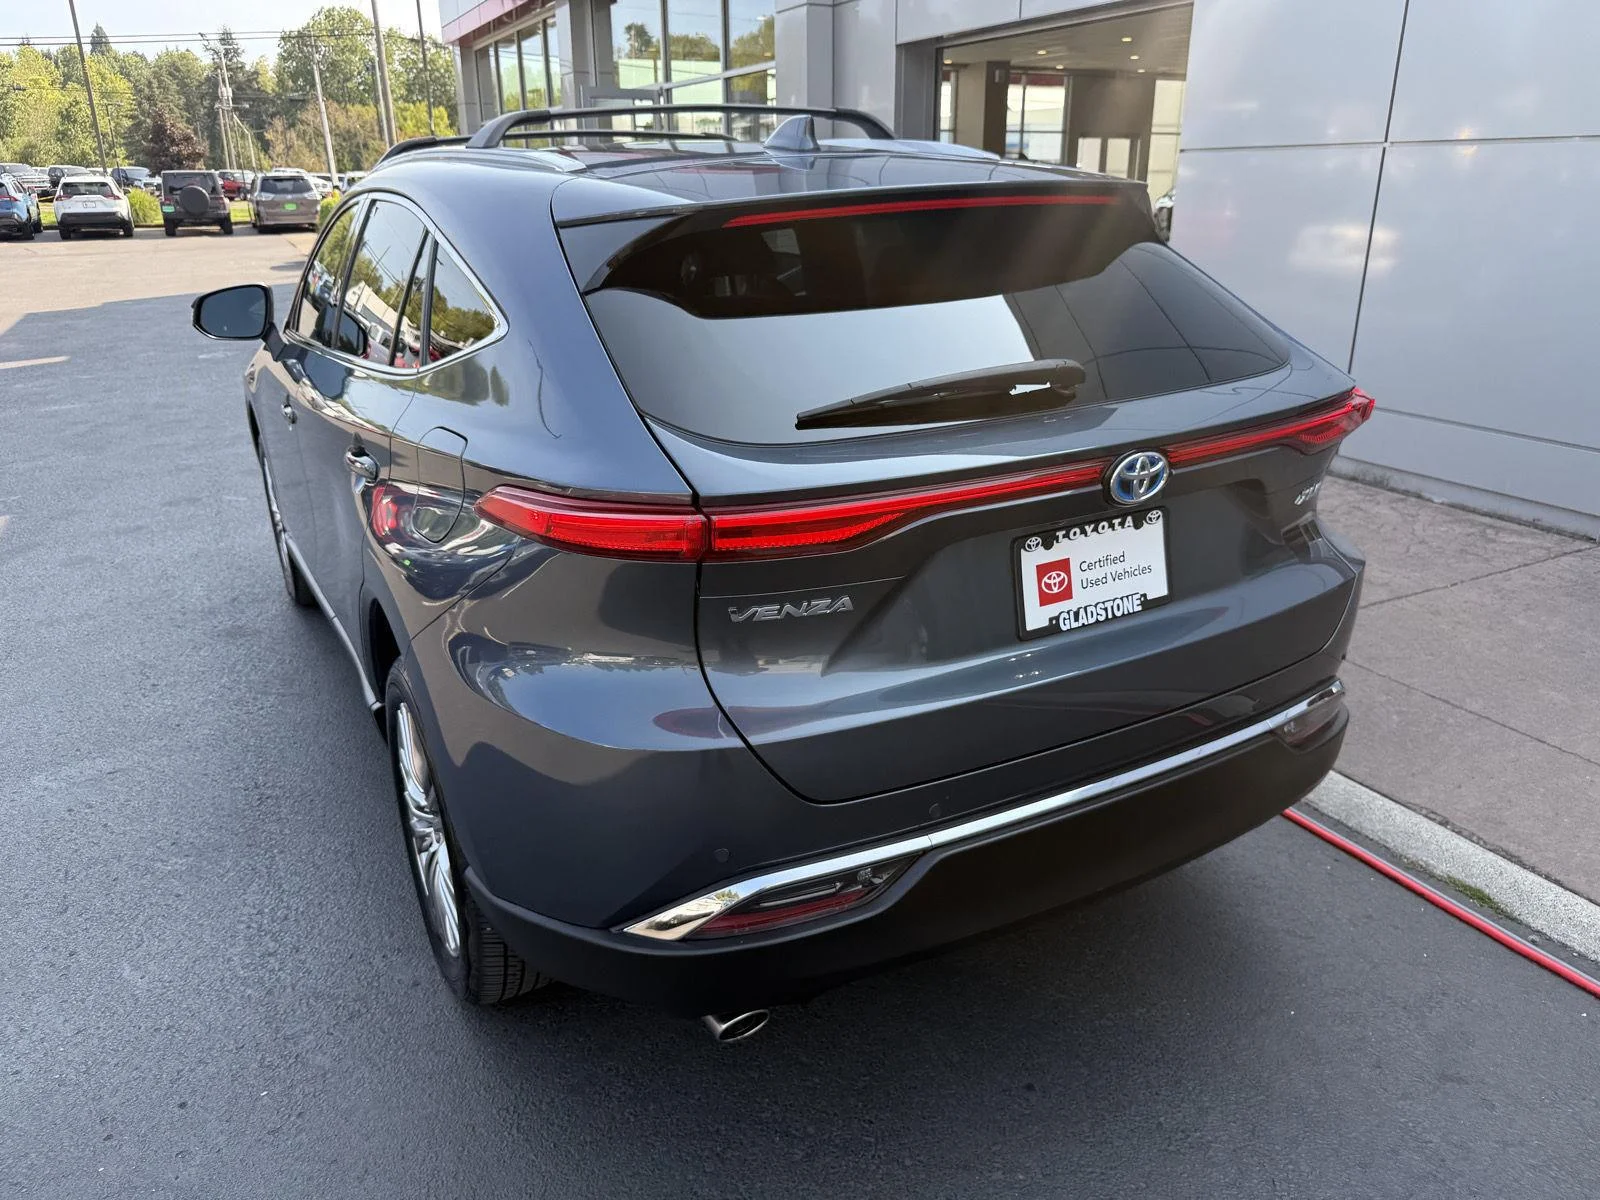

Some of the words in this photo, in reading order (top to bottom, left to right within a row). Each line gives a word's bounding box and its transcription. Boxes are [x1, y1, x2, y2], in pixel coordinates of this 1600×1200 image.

[1056, 516, 1134, 543] TOYOTA
[1079, 551, 1126, 572] Certified
[1080, 574, 1108, 590] Used
[1110, 564, 1152, 583] Vehicles
[728, 595, 854, 623] VENZA
[1058, 593, 1142, 631] GLADSTONE
